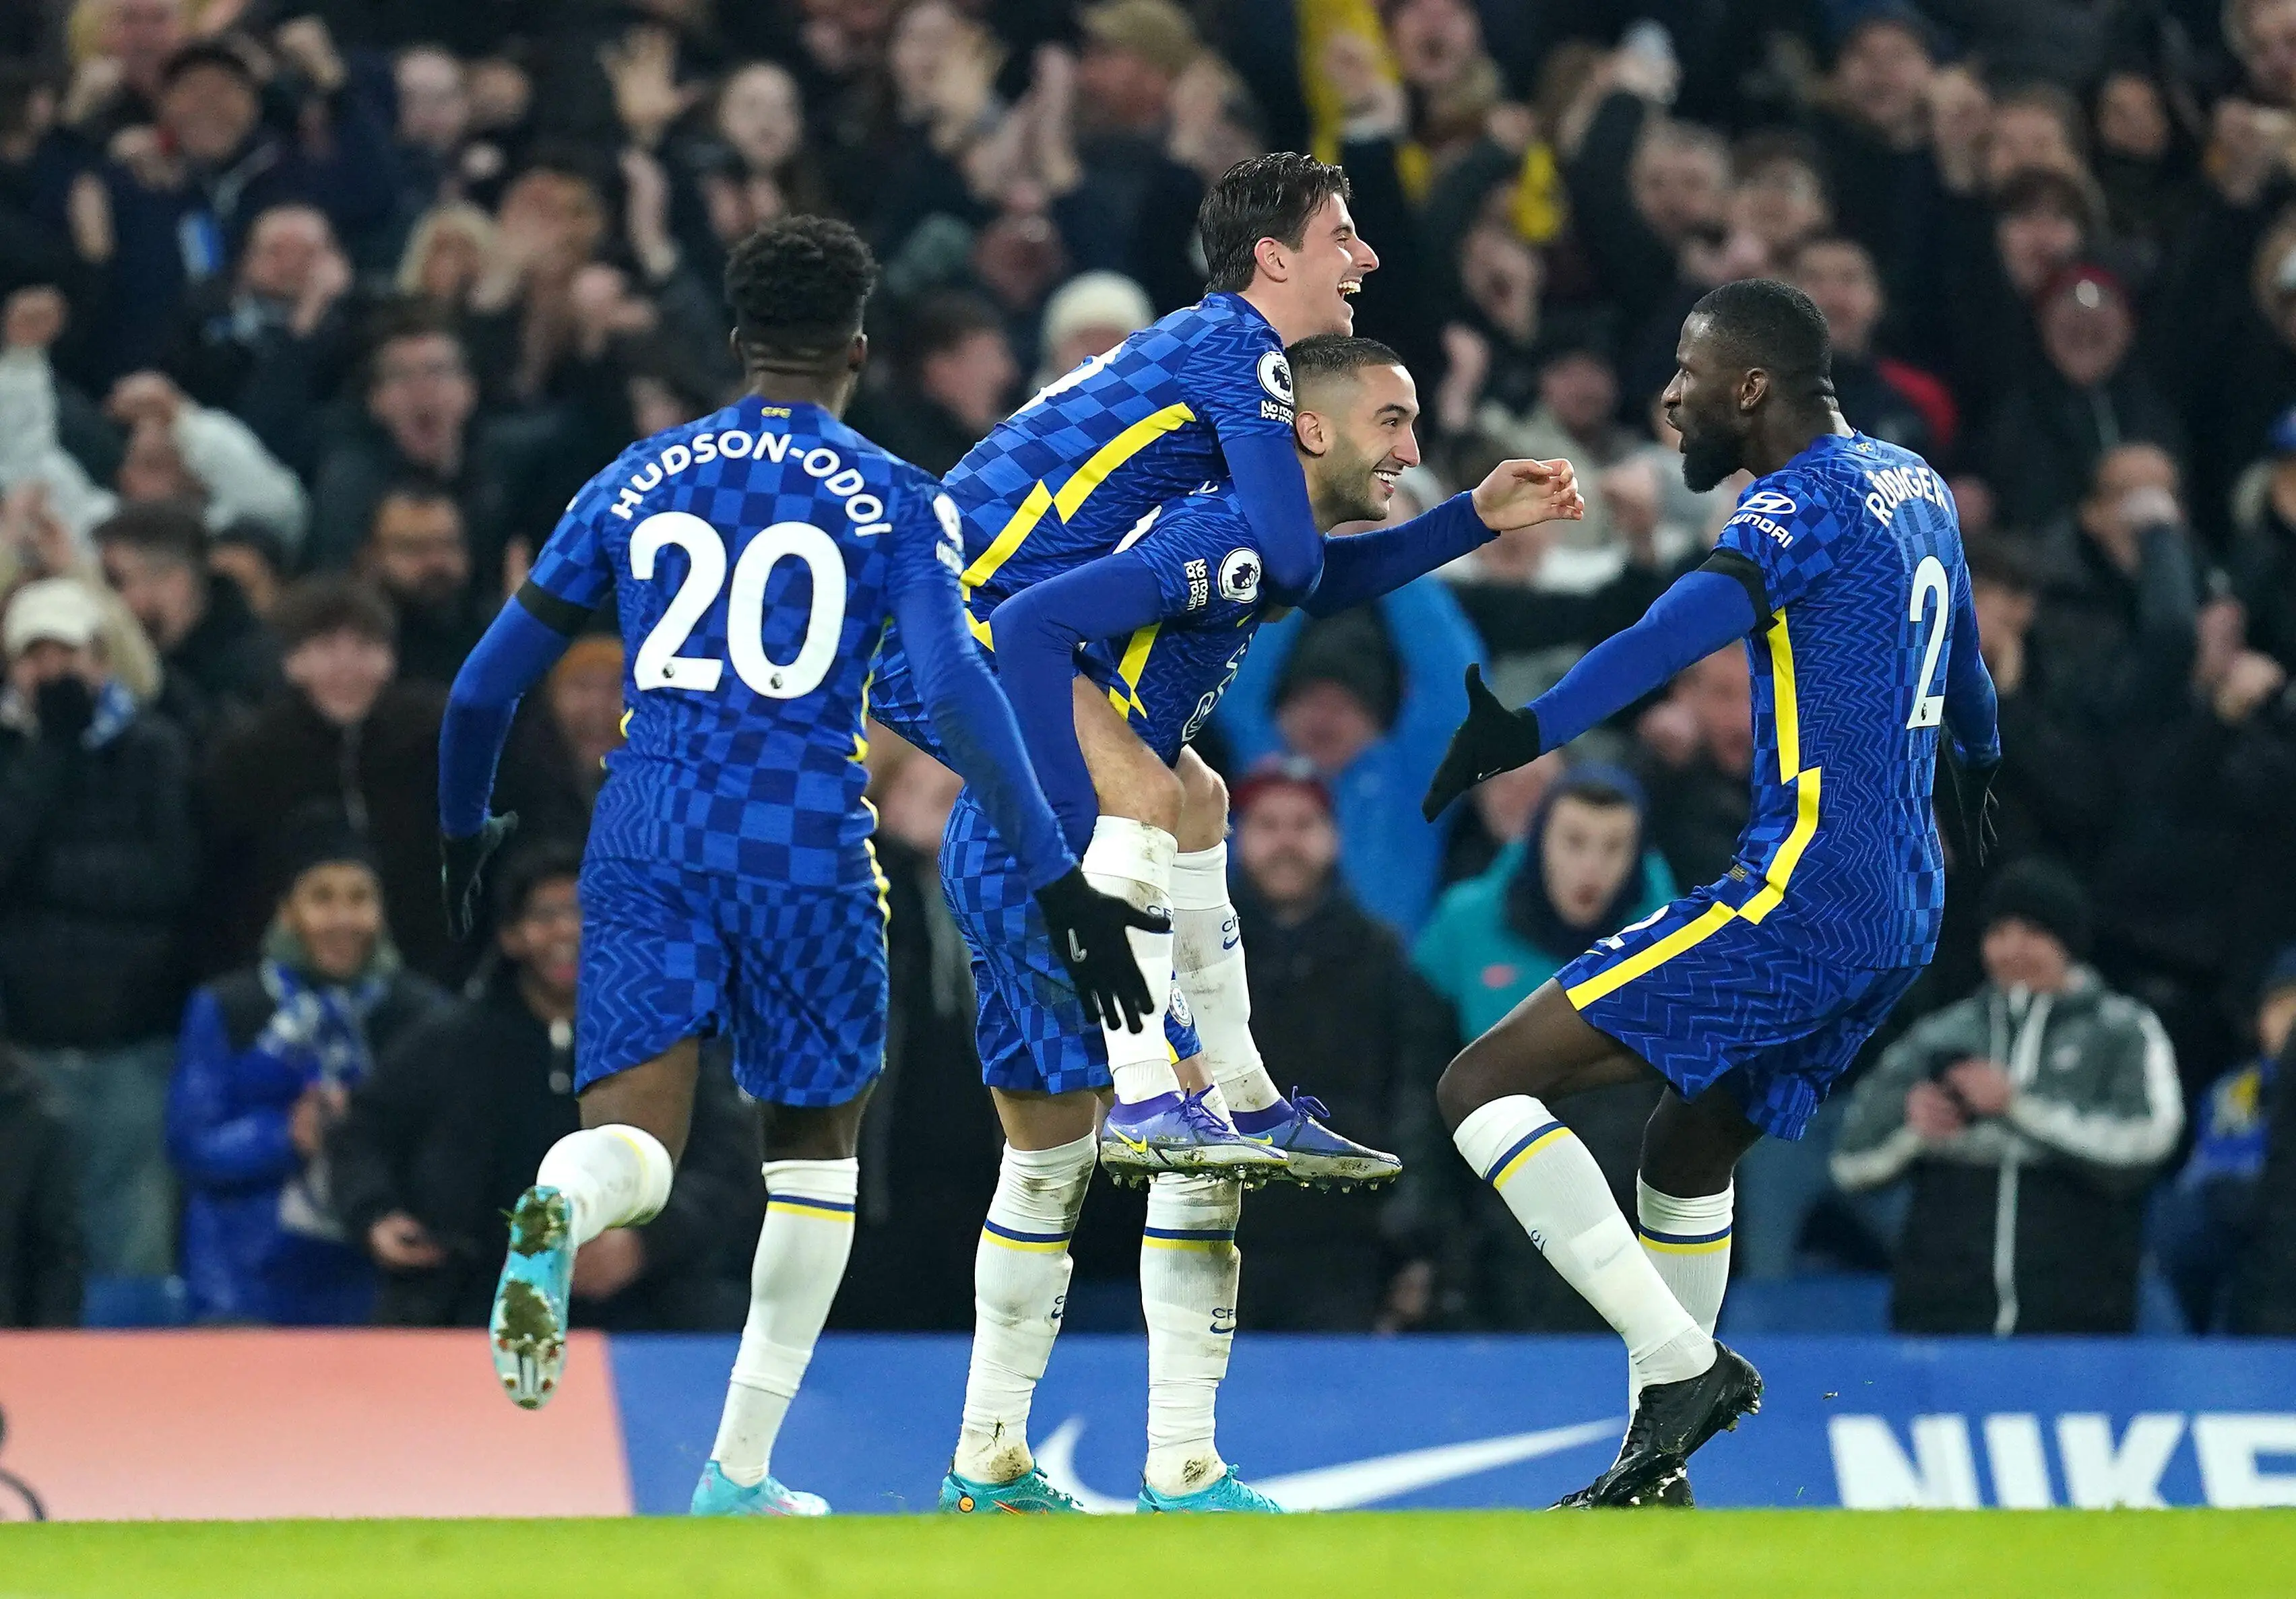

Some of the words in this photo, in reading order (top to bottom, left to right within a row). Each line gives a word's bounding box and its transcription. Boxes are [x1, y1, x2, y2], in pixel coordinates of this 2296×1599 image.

[1261, 400, 1279, 414] No
[1279, 405, 1294, 421] roo
[611, 430, 893, 537] HUDSON-ODOI
[1722, 513, 1794, 549] UNDAI
[1195, 558, 1207, 578] No
[629, 511, 848, 699] 20
[1905, 555, 1950, 730] 2
[1147, 905, 1172, 919] CF
[1221, 913, 1241, 932] CF
[1212, 1307, 1234, 1319] CF
